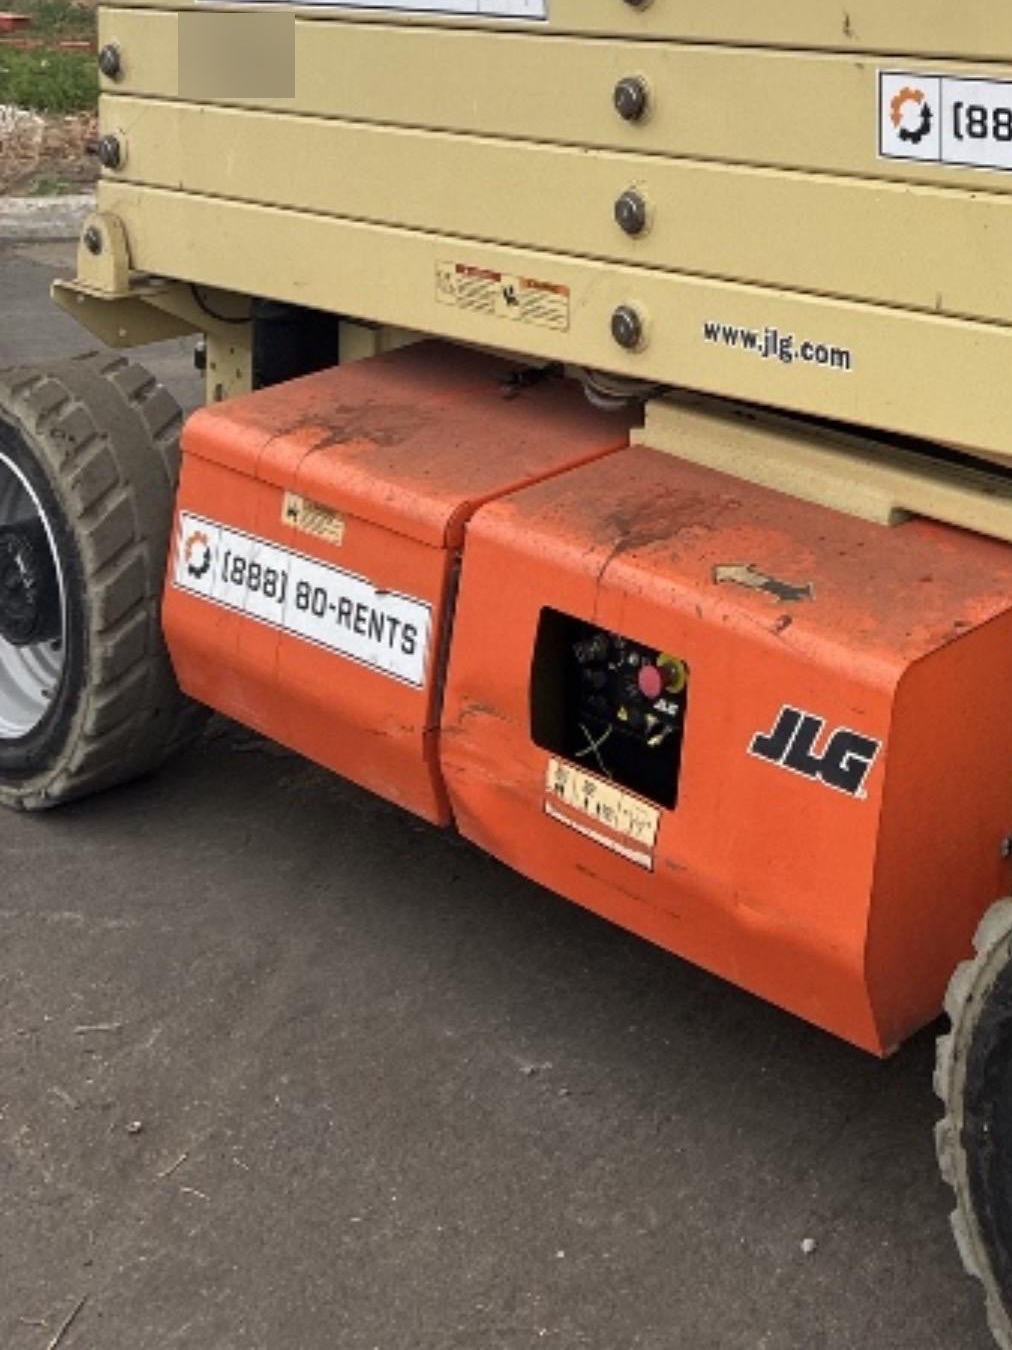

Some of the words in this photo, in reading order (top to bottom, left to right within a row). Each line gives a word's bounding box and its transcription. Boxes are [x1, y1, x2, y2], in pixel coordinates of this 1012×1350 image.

[703, 319, 852, 371] www.jlg.com
[221, 550, 288, 604] (888)
[295, 580, 418, 656] 80-RENTS
[747, 704, 883, 800] JLG
